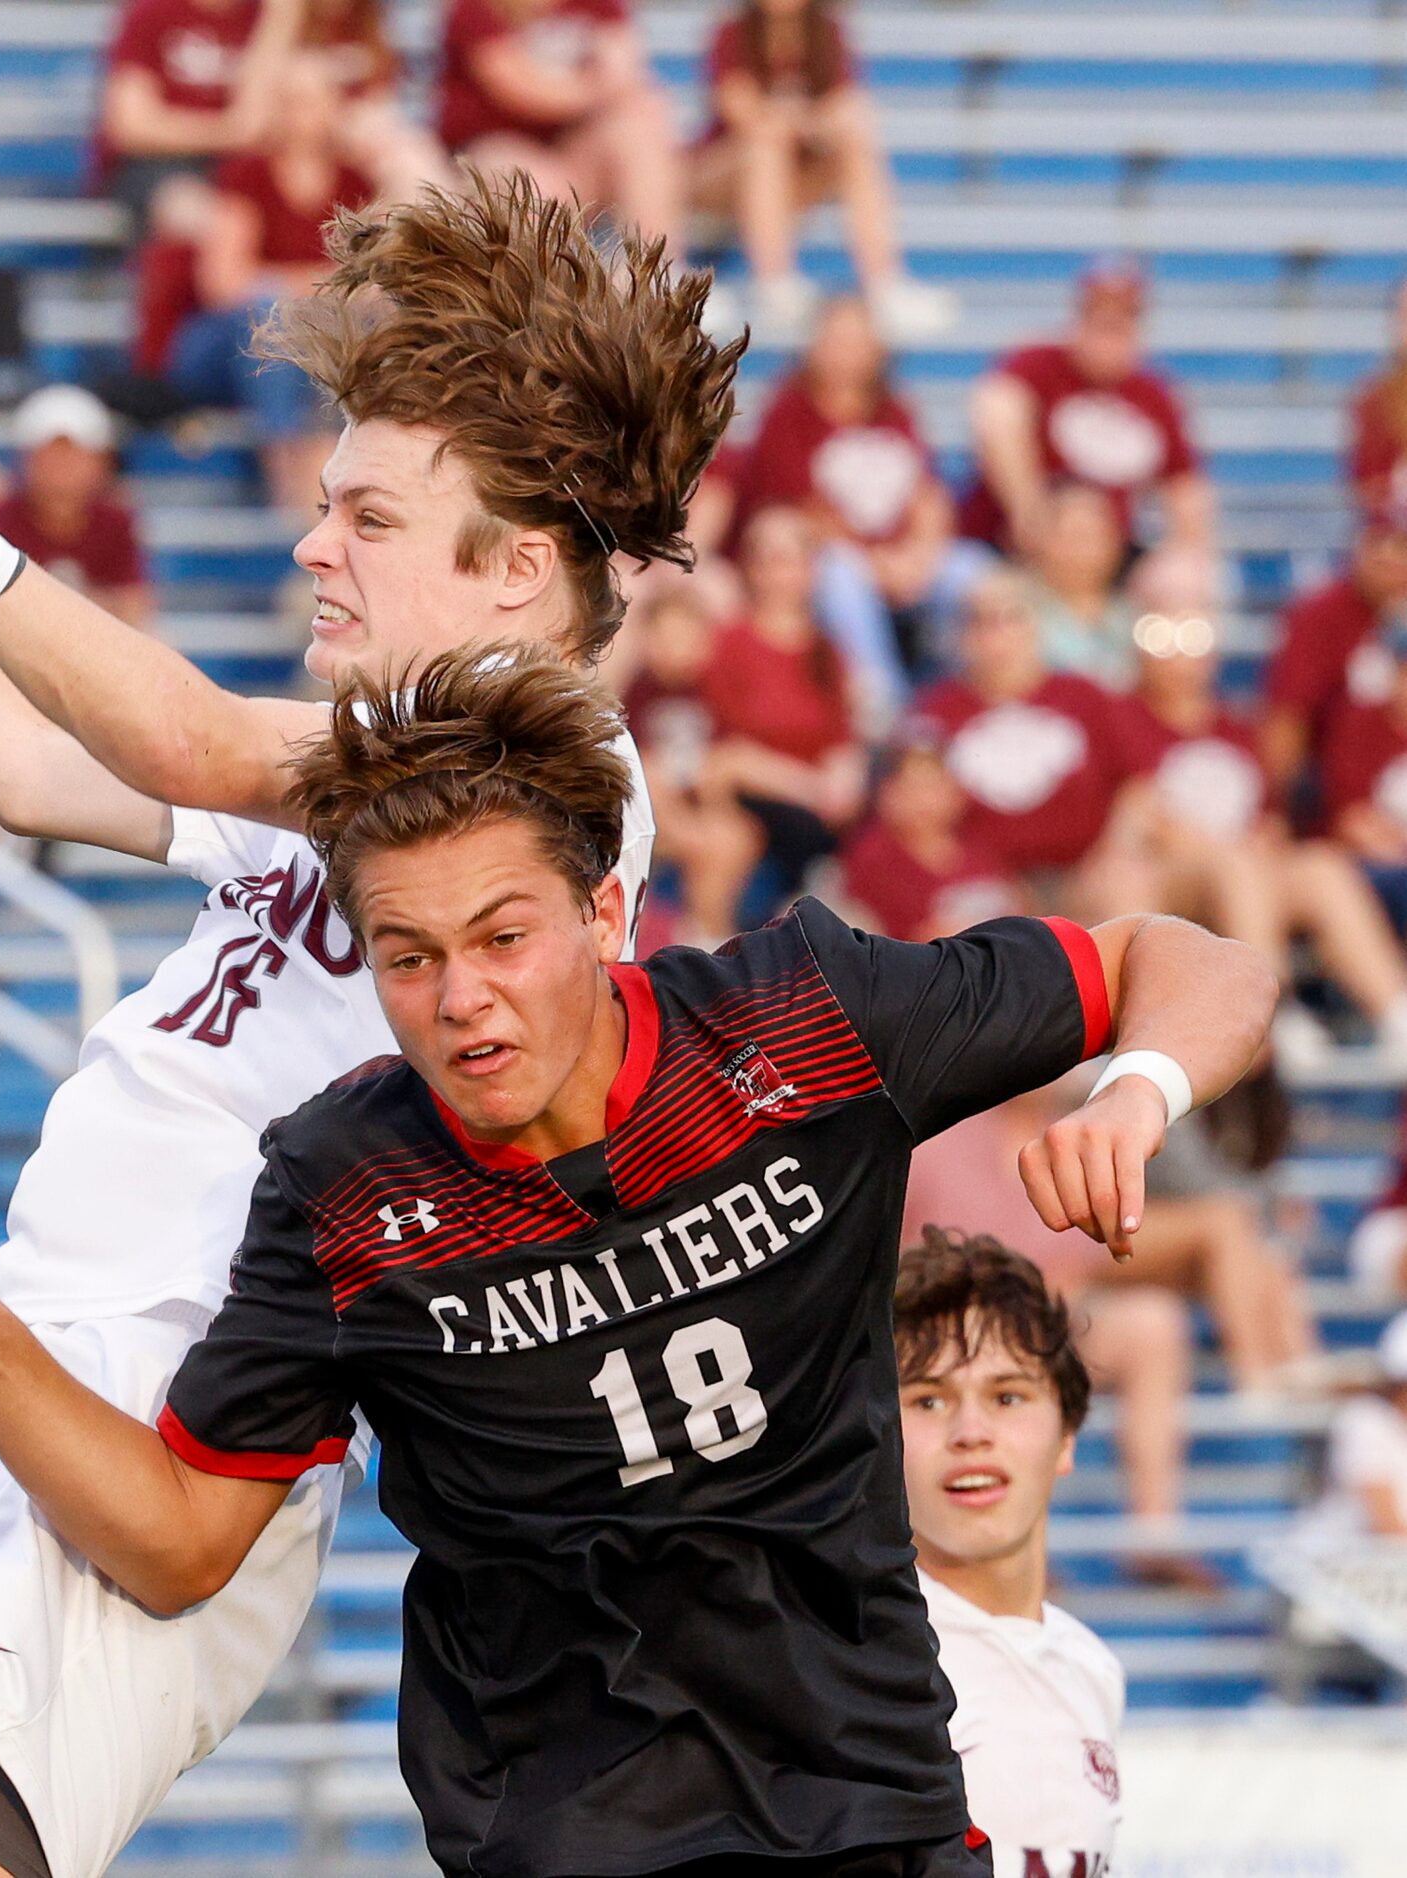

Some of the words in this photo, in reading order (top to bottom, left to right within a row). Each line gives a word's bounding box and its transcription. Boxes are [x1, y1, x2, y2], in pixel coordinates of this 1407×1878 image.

[148, 933, 289, 1047] 16
[428, 1155, 824, 1354] CAVALIERS
[589, 1317, 768, 1488] 18
